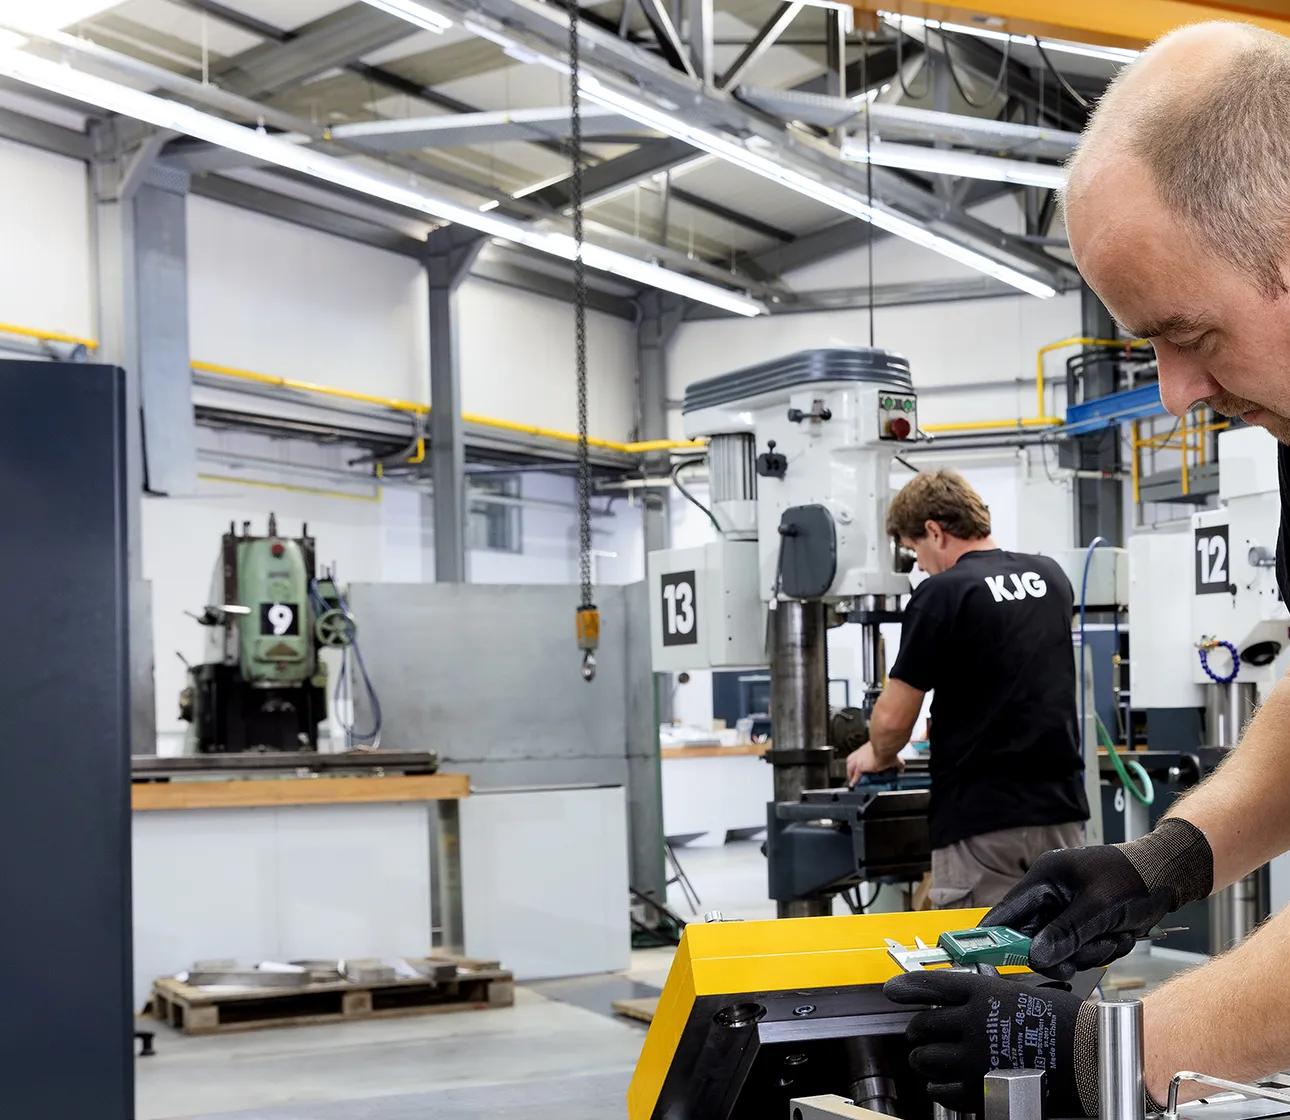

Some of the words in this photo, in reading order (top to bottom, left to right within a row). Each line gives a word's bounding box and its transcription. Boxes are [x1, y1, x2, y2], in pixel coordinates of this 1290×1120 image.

[1197, 535, 1227, 584] 12
[984, 571, 1047, 602] KJG
[268, 604, 293, 635] 9
[663, 582, 694, 634] 13
[1114, 788, 1124, 812] 6
[1016, 993, 1027, 1025] 48-101
[1000, 1019, 1009, 1057] Ansell
